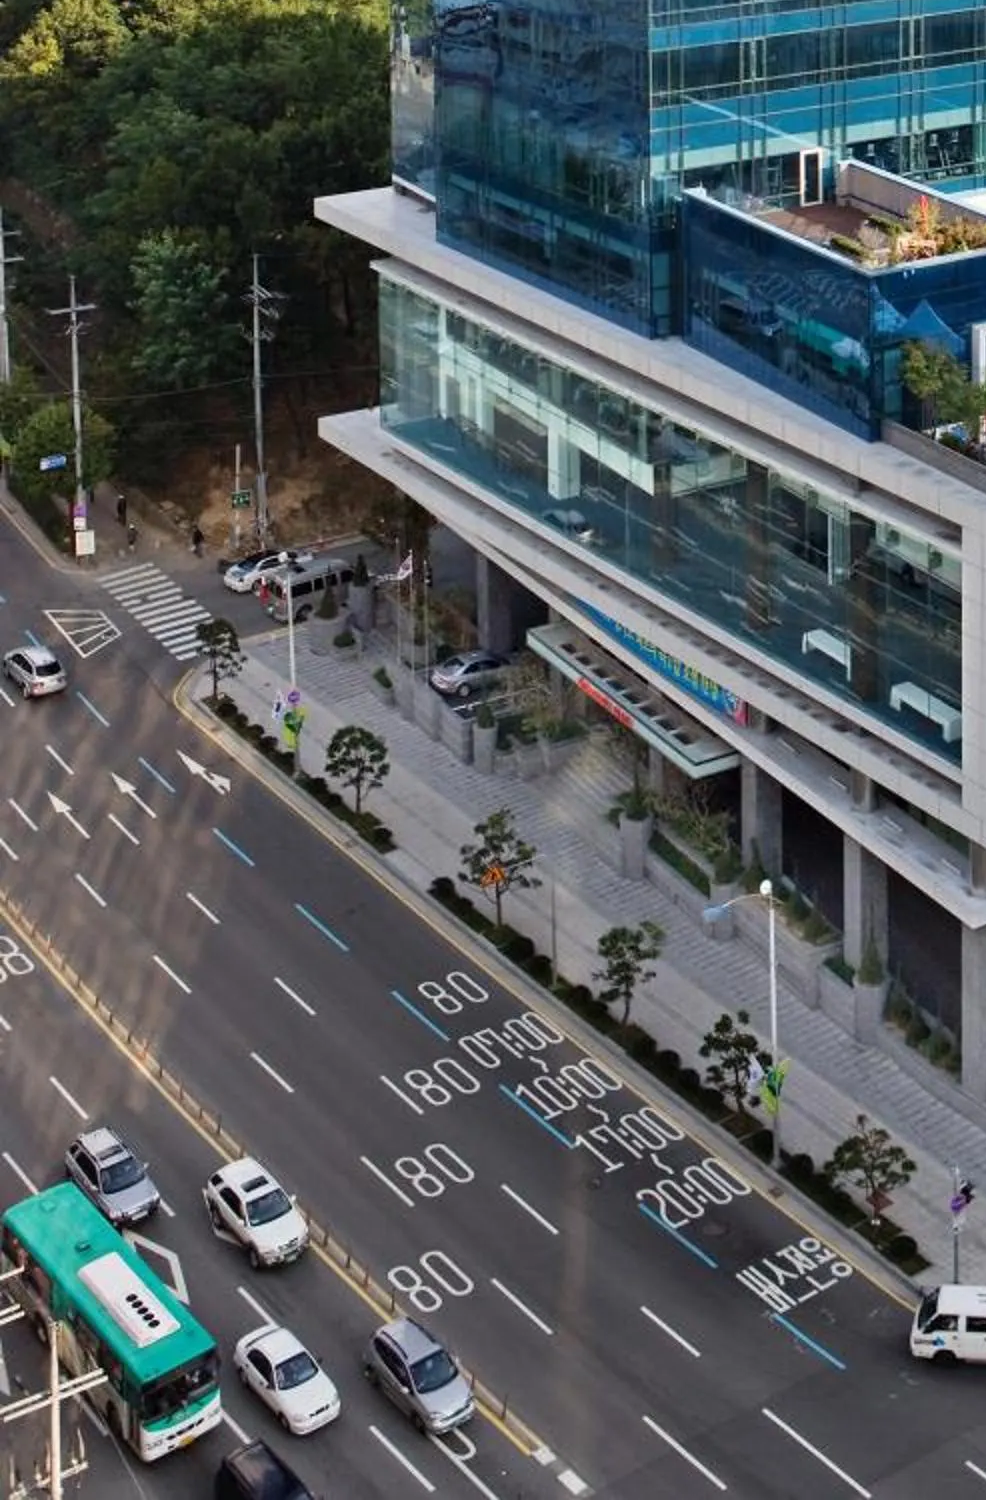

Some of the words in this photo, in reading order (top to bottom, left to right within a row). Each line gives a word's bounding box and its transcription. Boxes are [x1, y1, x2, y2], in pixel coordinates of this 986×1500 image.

[417, 971, 489, 1014] 80
[458, 1011, 565, 1069] 07:00
[404, 1057, 481, 1106] 80
[516, 1056, 623, 1120] 10:00
[395, 1143, 475, 1198] 80
[574, 1107, 685, 1173] 17:00
[636, 1158, 751, 1229] 20:00
[387, 1250, 475, 1313] 80
[735, 1237, 854, 1314] 버스전용
